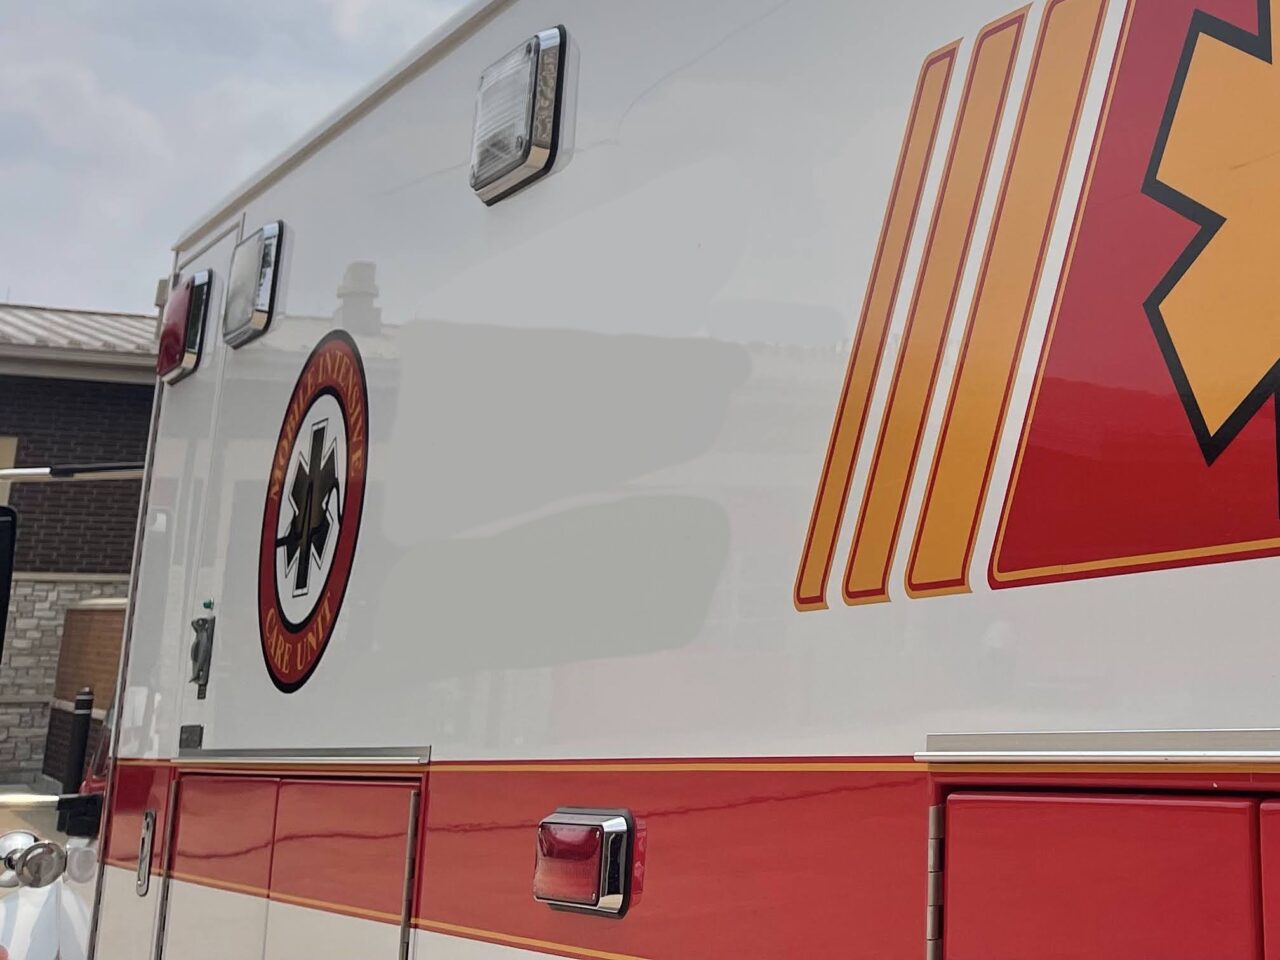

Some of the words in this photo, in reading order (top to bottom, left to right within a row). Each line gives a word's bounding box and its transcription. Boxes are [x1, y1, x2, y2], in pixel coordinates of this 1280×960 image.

[269, 366, 316, 500] MOBILE
[317, 349, 363, 477] INTENSIVE
[265, 607, 293, 674] CARE
[296, 591, 331, 670] UNIT
